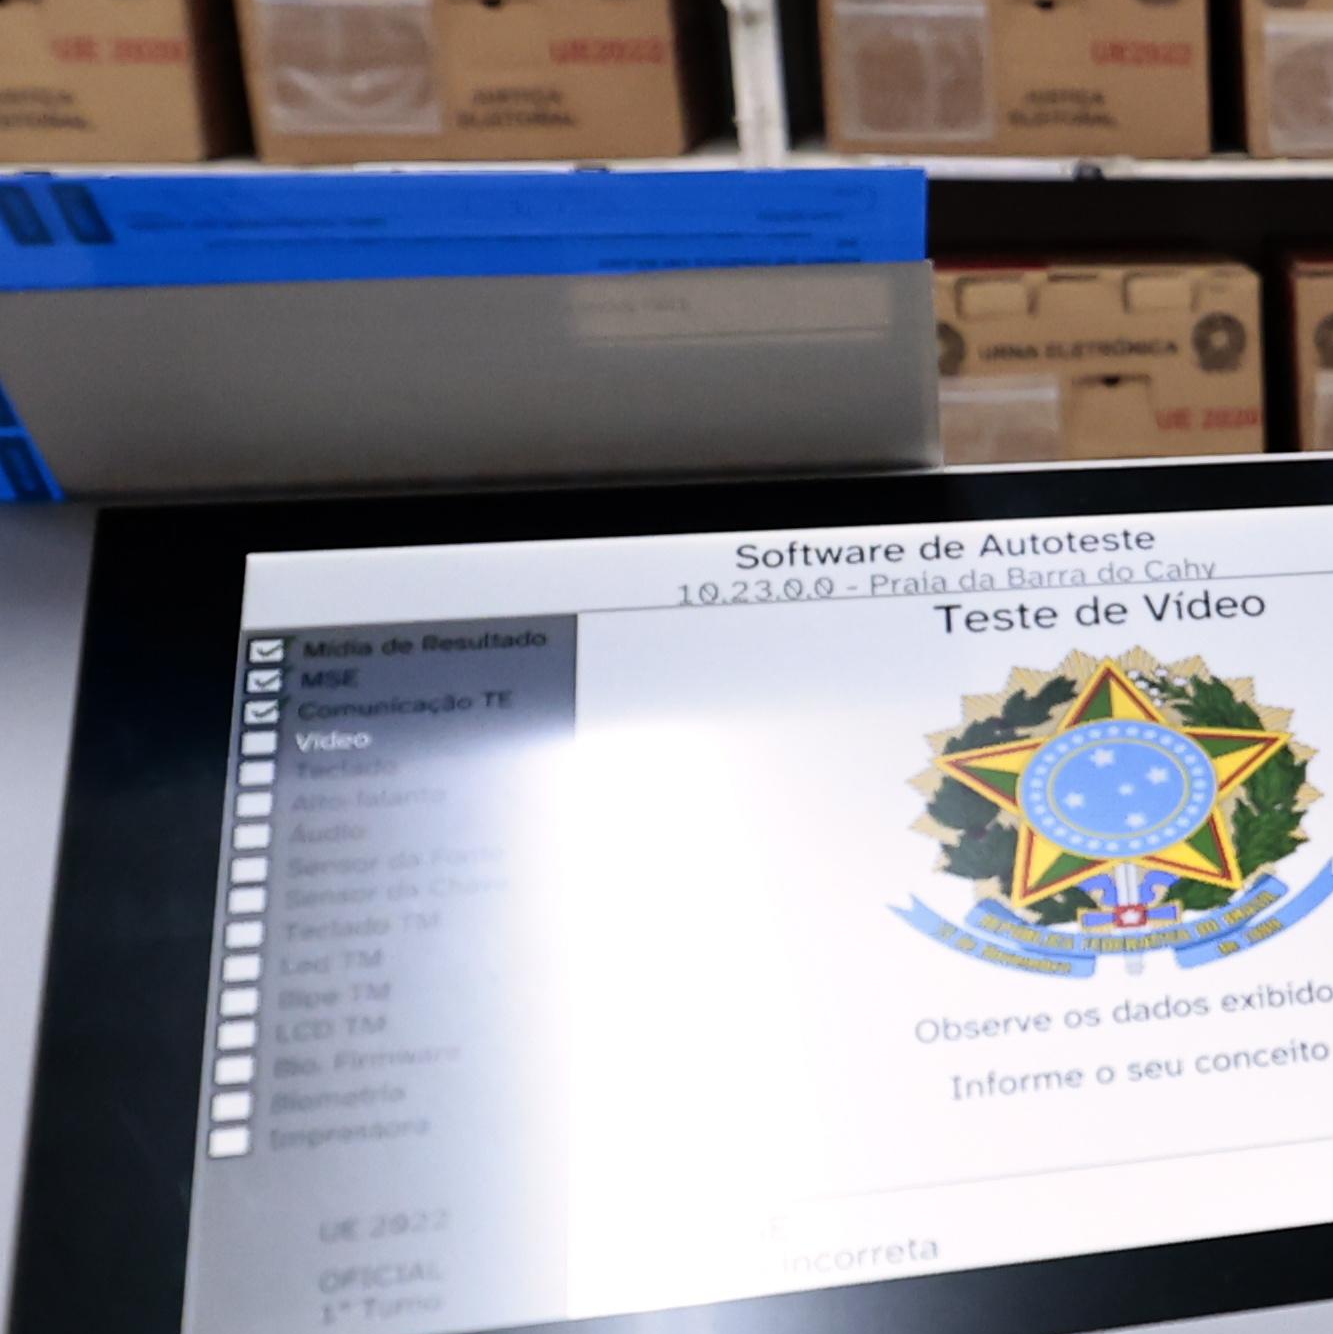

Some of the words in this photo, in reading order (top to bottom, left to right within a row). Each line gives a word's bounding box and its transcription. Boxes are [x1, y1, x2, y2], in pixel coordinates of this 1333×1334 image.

[735, 536, 905, 570] Software
[919, 534, 965, 562] de
[979, 527, 1156, 558] Autoteste
[677, 576, 835, 607] 10.23.0.0
[869, 570, 948, 598] Praia
[960, 568, 996, 593] da
[1007, 562, 1086, 589] Barra
[1098, 559, 1134, 585] do
[1144, 557, 1217, 583] Cahy
[934, 602, 1058, 635] Teste
[1075, 595, 1128, 626] de
[1144, 588, 1266, 621] Vídeo
[381, 634, 413, 656] de
[421, 629, 548, 653] Resultado
[297, 692, 473, 721] Comunicação
[914, 1007, 1053, 1046] Observe
[1065, 1005, 1102, 1030] os
[1113, 991, 1210, 1026] dados
[951, 1063, 1085, 1102] Informe
[1096, 1062, 1117, 1084] o
[1128, 1055, 1184, 1082] seu
[1194, 1035, 1331, 1076] conceito
